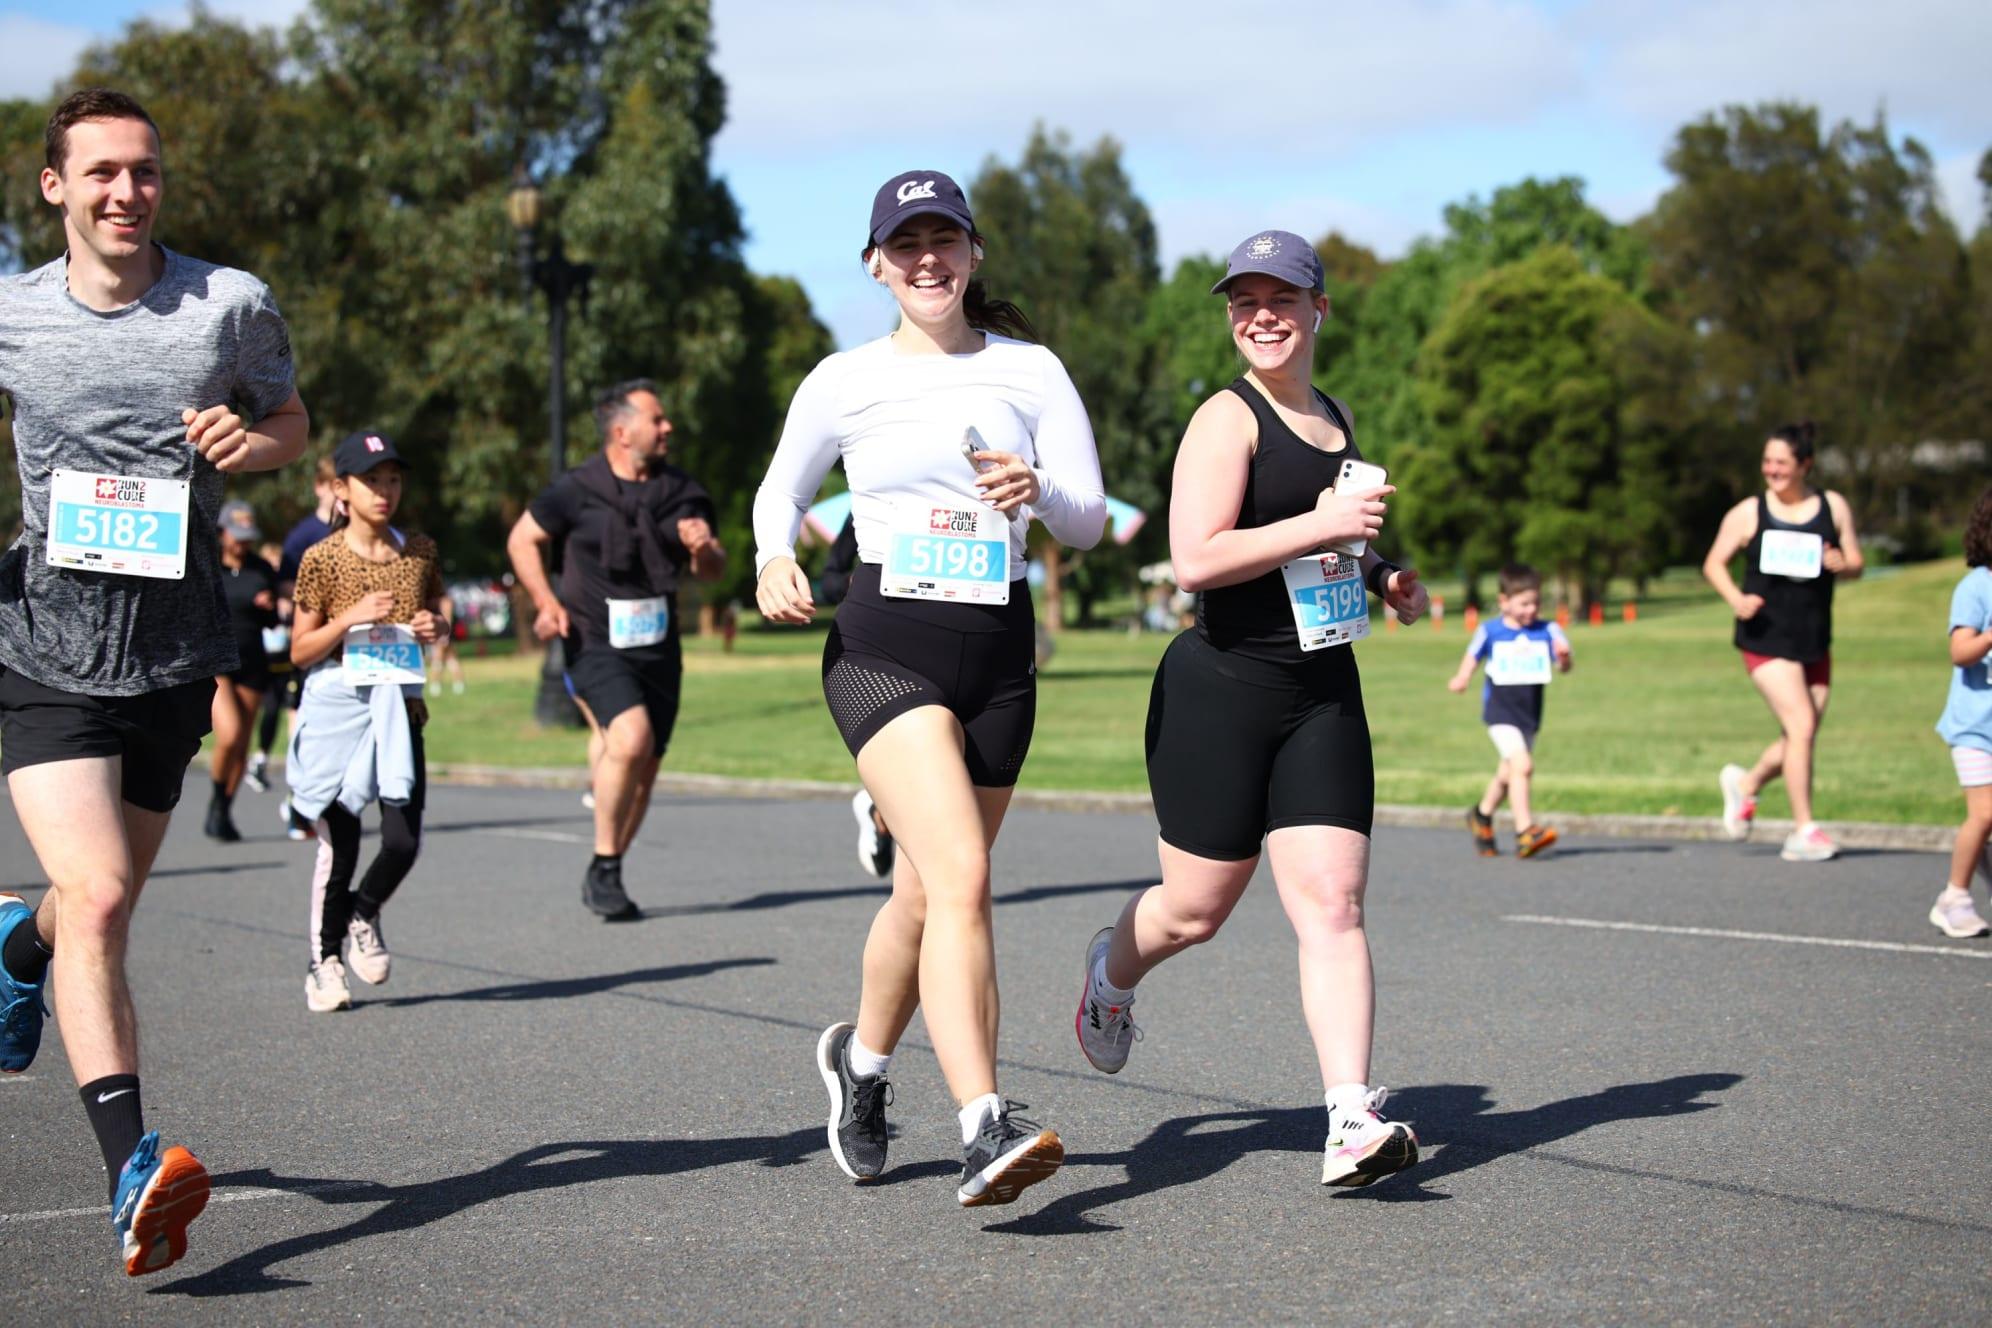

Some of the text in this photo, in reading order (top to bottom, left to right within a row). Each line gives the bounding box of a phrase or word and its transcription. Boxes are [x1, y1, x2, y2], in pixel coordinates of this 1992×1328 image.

[897, 180, 936, 206] Cal
[75, 508, 159, 550] 5182
[910, 538, 989, 578] 5198
[1314, 582, 1363, 622] 5199
